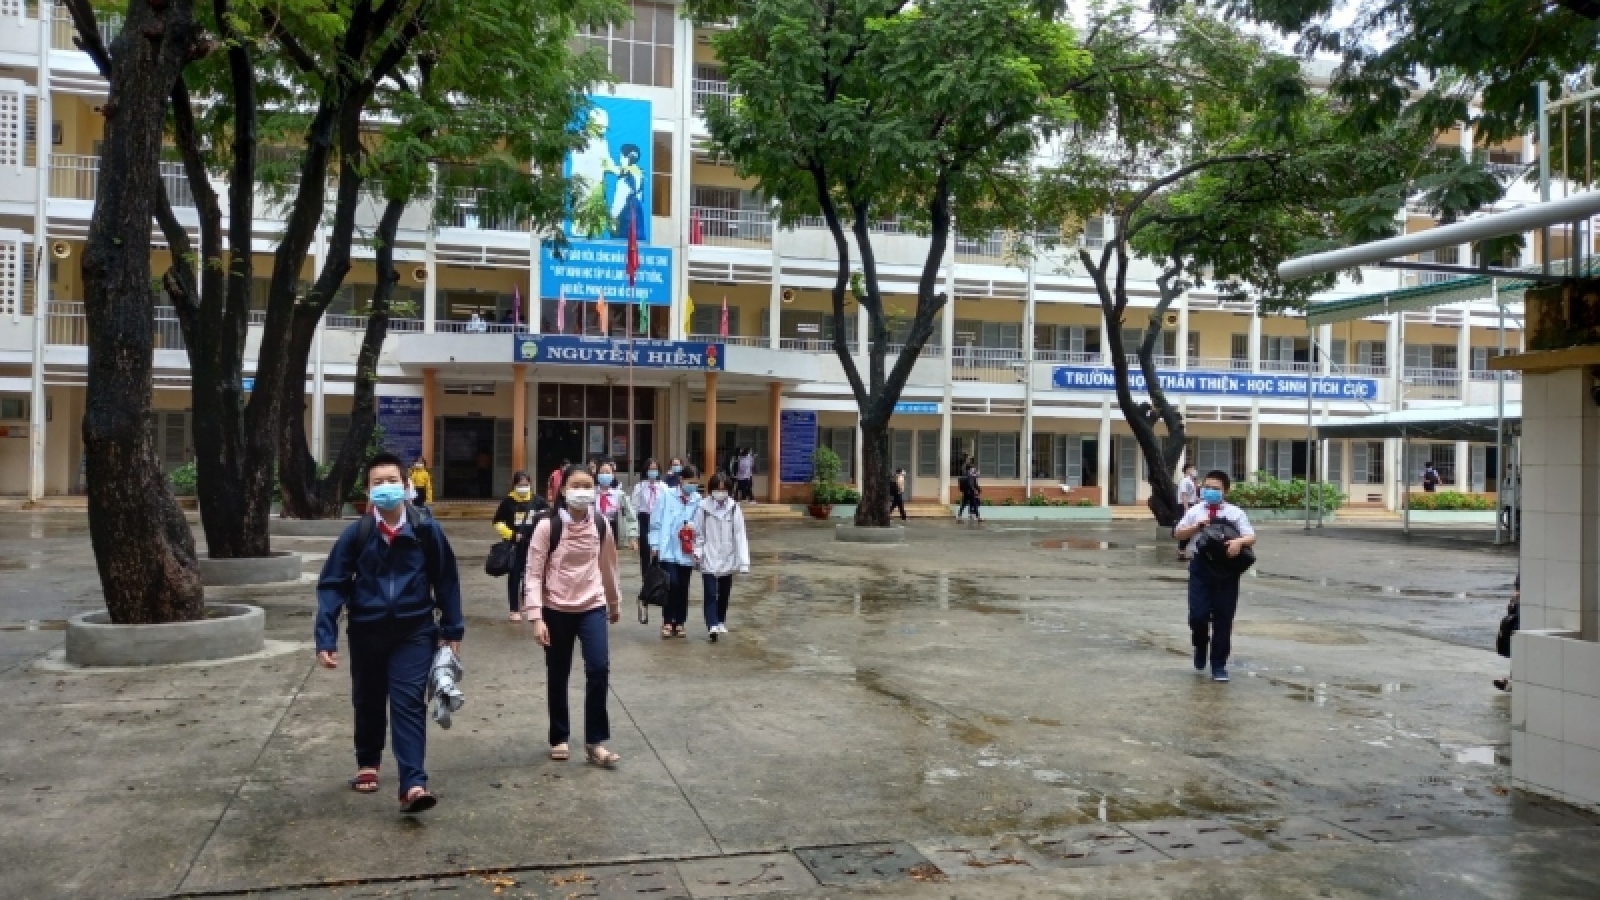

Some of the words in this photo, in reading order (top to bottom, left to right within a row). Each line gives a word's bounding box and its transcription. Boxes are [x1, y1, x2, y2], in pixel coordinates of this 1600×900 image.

[1065, 367, 1116, 385] TRƯỜN
[1158, 373, 1195, 389] THÂN
[1198, 375, 1239, 393] THIỆN
[1247, 378, 1274, 394] HỌC
[1277, 379, 1307, 393] SINH
[1311, 377, 1339, 395] TÍCH
